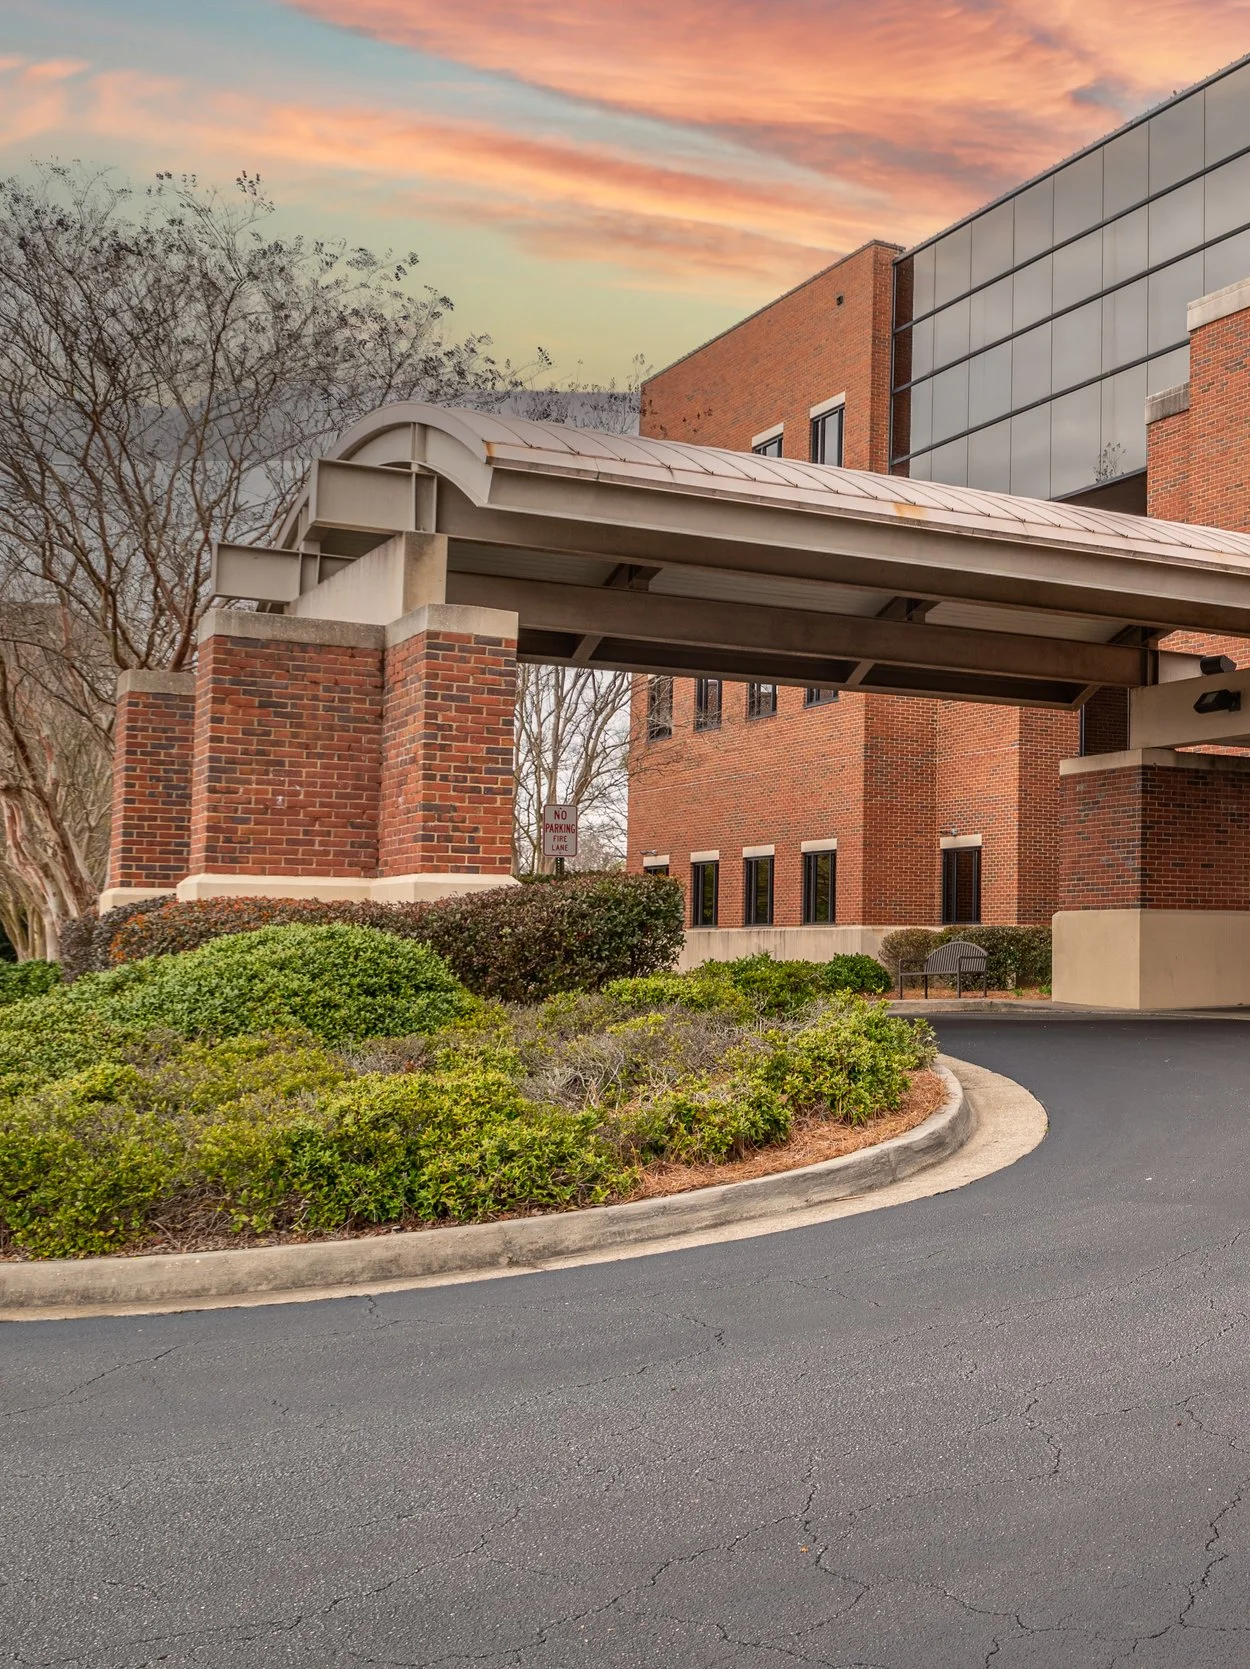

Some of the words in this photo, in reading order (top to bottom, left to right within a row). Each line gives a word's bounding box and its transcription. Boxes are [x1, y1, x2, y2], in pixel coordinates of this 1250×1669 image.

[554, 810, 567, 820] NO
[545, 823, 576, 834] PARKING
[553, 835, 567, 843] FIRE
